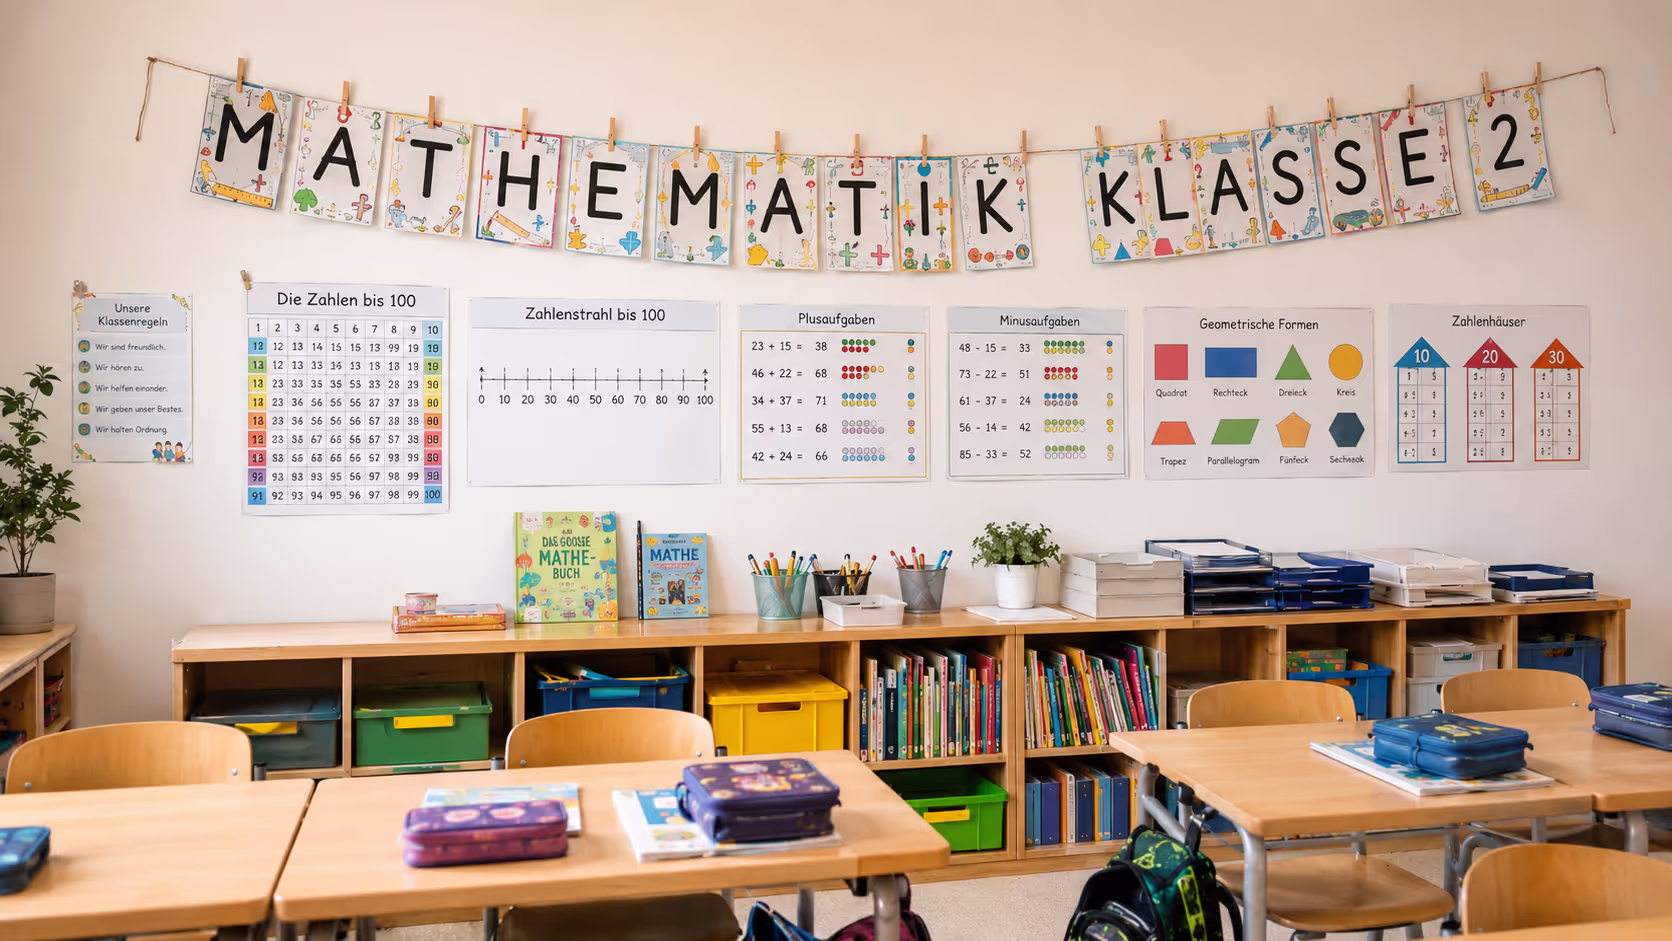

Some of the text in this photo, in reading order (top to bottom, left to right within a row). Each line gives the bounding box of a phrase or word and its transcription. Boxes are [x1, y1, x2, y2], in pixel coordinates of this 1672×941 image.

[1489, 113, 1525, 172] 2
[278, 292, 415, 307] Die Zahlen bis 100
[115, 304, 150, 313] Unsere
[526, 307, 665, 321] Zahlenstrahl bis 100
[99, 316, 167, 329] Klassenregeln
[799, 313, 874, 328] Plusaufgaben
[1000, 315, 1079, 329] Minusaufgaben
[1200, 318, 1318, 330] Geometrische Formen
[1452, 315, 1525, 327] Zahlenhäuser
[257, 323, 438, 334] 1 2 3 4 5 6 7 8 9 10
[274, 342, 283, 350] 12
[293, 342, 303, 351] 13
[313, 343, 322, 351] 14
[389, 344, 399, 352] 99
[752, 341, 763, 350] 23
[781, 342, 791, 351] 15
[816, 342, 827, 351] 38
[959, 343, 970, 352] 48
[986, 343, 996, 352] 15
[1020, 344, 1030, 352] 33
[1414, 349, 1430, 363] 10
[1482, 349, 1498, 363] 20
[1548, 350, 1564, 364] 30
[273, 361, 283, 369] 12
[292, 361, 303, 369] 13
[752, 369, 764, 378] 46
[780, 369, 791, 378] 22
[815, 369, 827, 378] 68
[960, 370, 970, 378] 73
[985, 370, 996, 378] 22
[1020, 370, 1029, 378] 51
[1279, 388, 1307, 396] Dreieck
[479, 395, 713, 405] 0 10 20 30 40 50 60 70 80 90 100
[752, 396, 764, 405] 34
[780, 396, 791, 405] 37
[816, 396, 826, 405] 71
[960, 396, 970, 405] 61
[986, 396, 996, 405] 37
[1020, 396, 1030, 405] 24
[111, 406, 133, 414] geben
[136, 426, 168, 435] Ordnung.
[752, 424, 764, 433] 55
[781, 424, 791, 433] 13
[816, 424, 827, 433] 68
[960, 423, 971, 432] 56
[987, 423, 996, 432] 14
[1020, 423, 1030, 431] 42
[752, 452, 764, 461] 42
[780, 452, 792, 461] 24
[816, 451, 828, 460] 66
[960, 450, 971, 459] 85
[986, 450, 997, 459] 33
[1020, 449, 1031, 458] 52
[1161, 457, 1186, 467] Trapez
[1208, 457, 1259, 467] Parallelogram
[1280, 456, 1308, 464] Fünfeck
[252, 492, 262, 500] 91
[272, 492, 283, 500] 92
[292, 492, 303, 500] 93
[311, 491, 322, 499] 94
[330, 491, 342, 499] 95
[425, 490, 440, 499] 100
[539, 550, 596, 566] MATHE-
[651, 548, 699, 561] MATHE
[553, 568, 580, 579] BUCH
